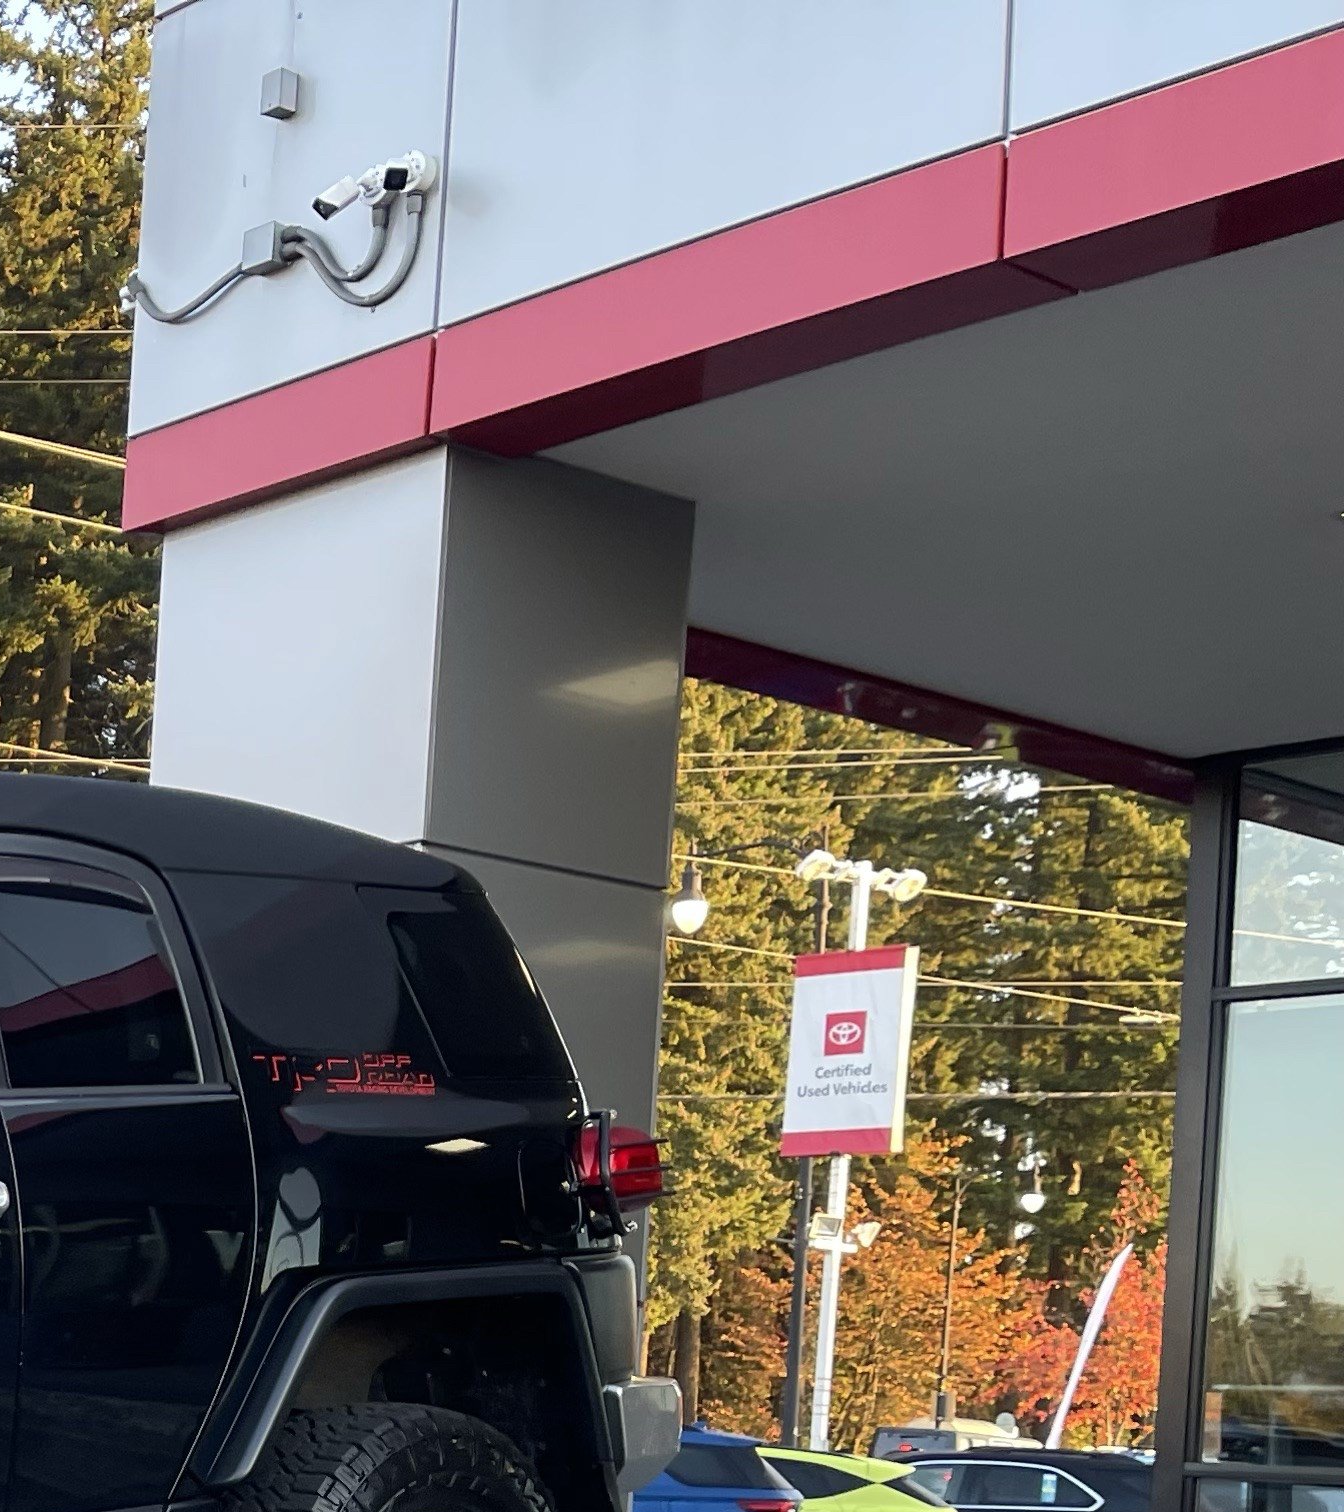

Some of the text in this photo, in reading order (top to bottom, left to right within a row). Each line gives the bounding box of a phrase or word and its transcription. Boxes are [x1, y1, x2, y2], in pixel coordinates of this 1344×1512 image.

[815, 1064, 872, 1079] Certified
[797, 1081, 888, 1098] Used Vehicles
